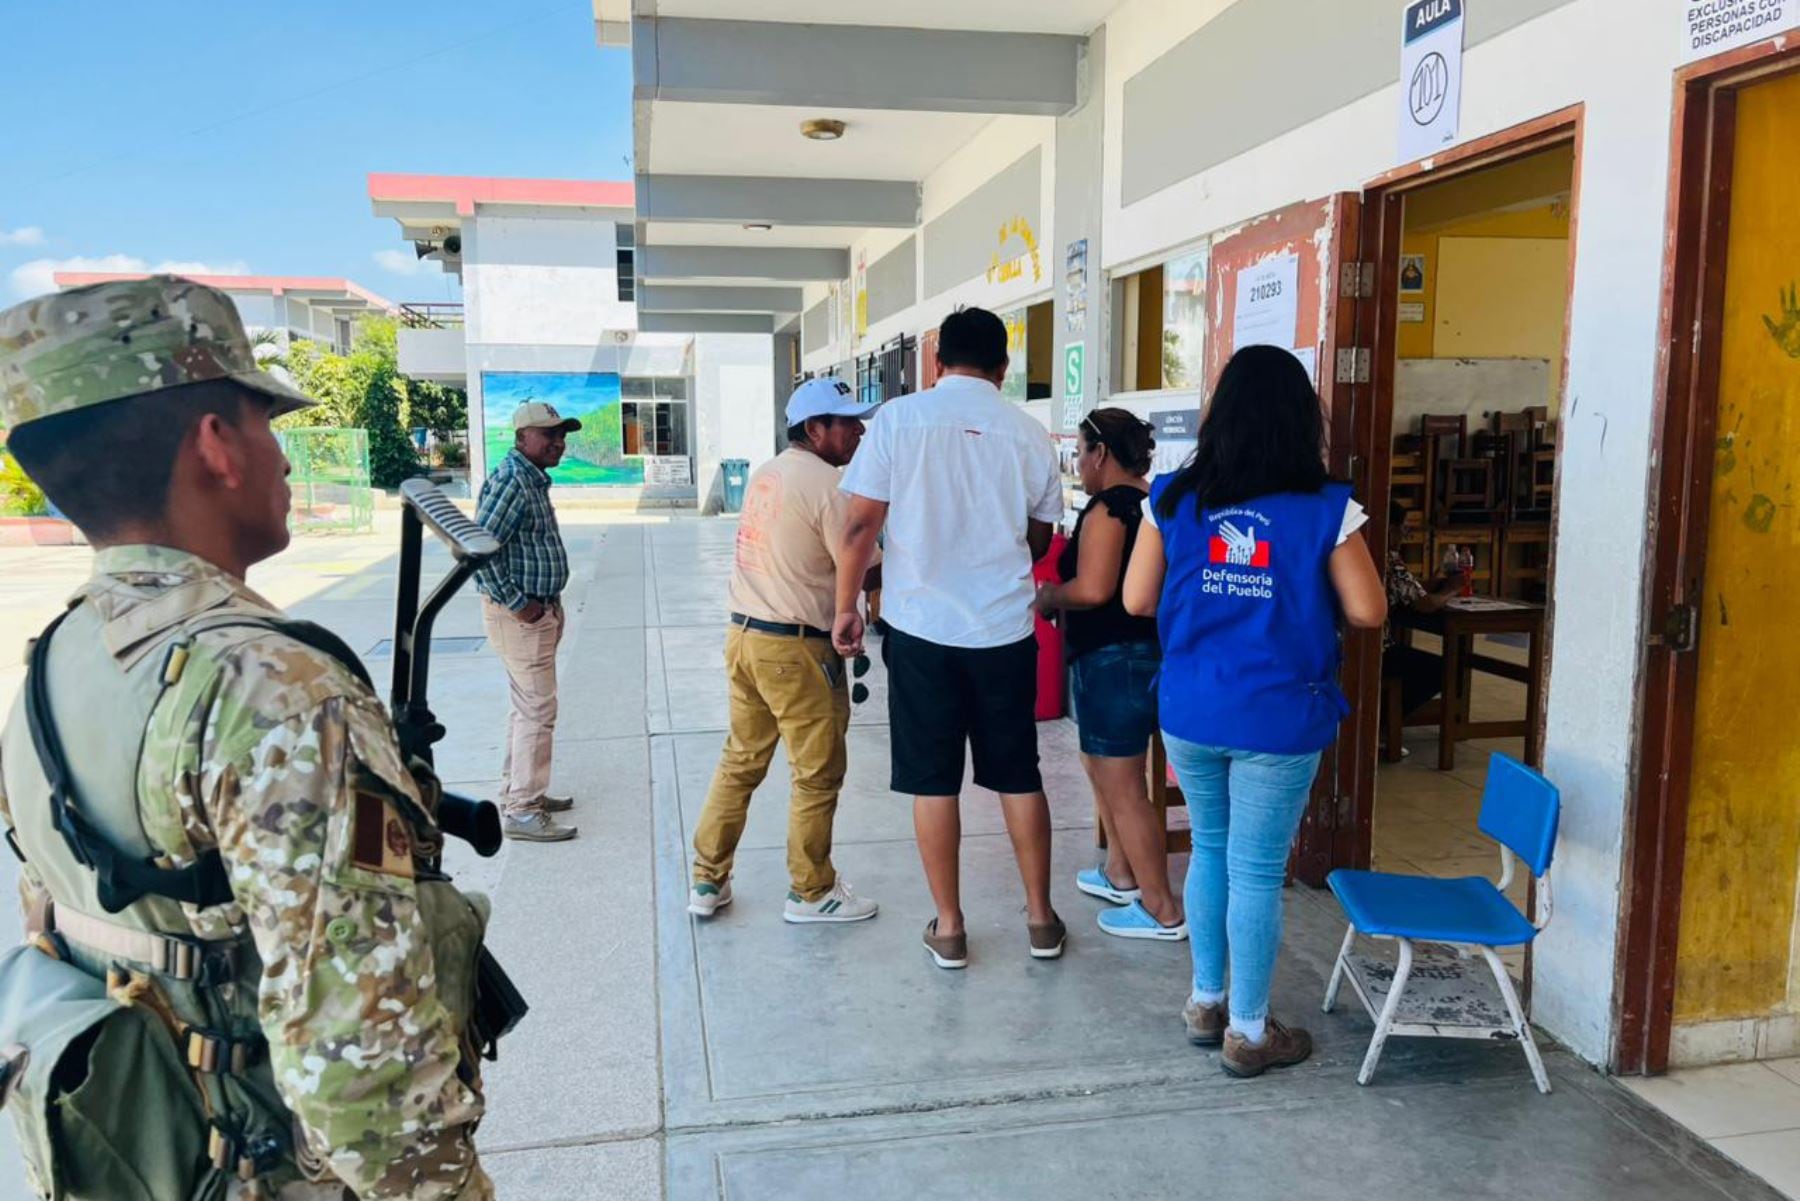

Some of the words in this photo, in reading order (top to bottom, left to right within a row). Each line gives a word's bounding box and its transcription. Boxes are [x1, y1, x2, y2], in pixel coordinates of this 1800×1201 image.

[1415, 0, 1451, 28] AULA
[1690, 2, 1755, 34] PERSONAS
[1692, 8, 1782, 49] DISCAPACIDAD
[1413, 55, 1441, 113] 101
[1250, 280, 1282, 302] 210293
[1067, 350, 1080, 394] S
[1202, 568, 1272, 586] Defensoría
[1202, 581, 1223, 594] del
[1228, 584, 1272, 599] Pueblo
